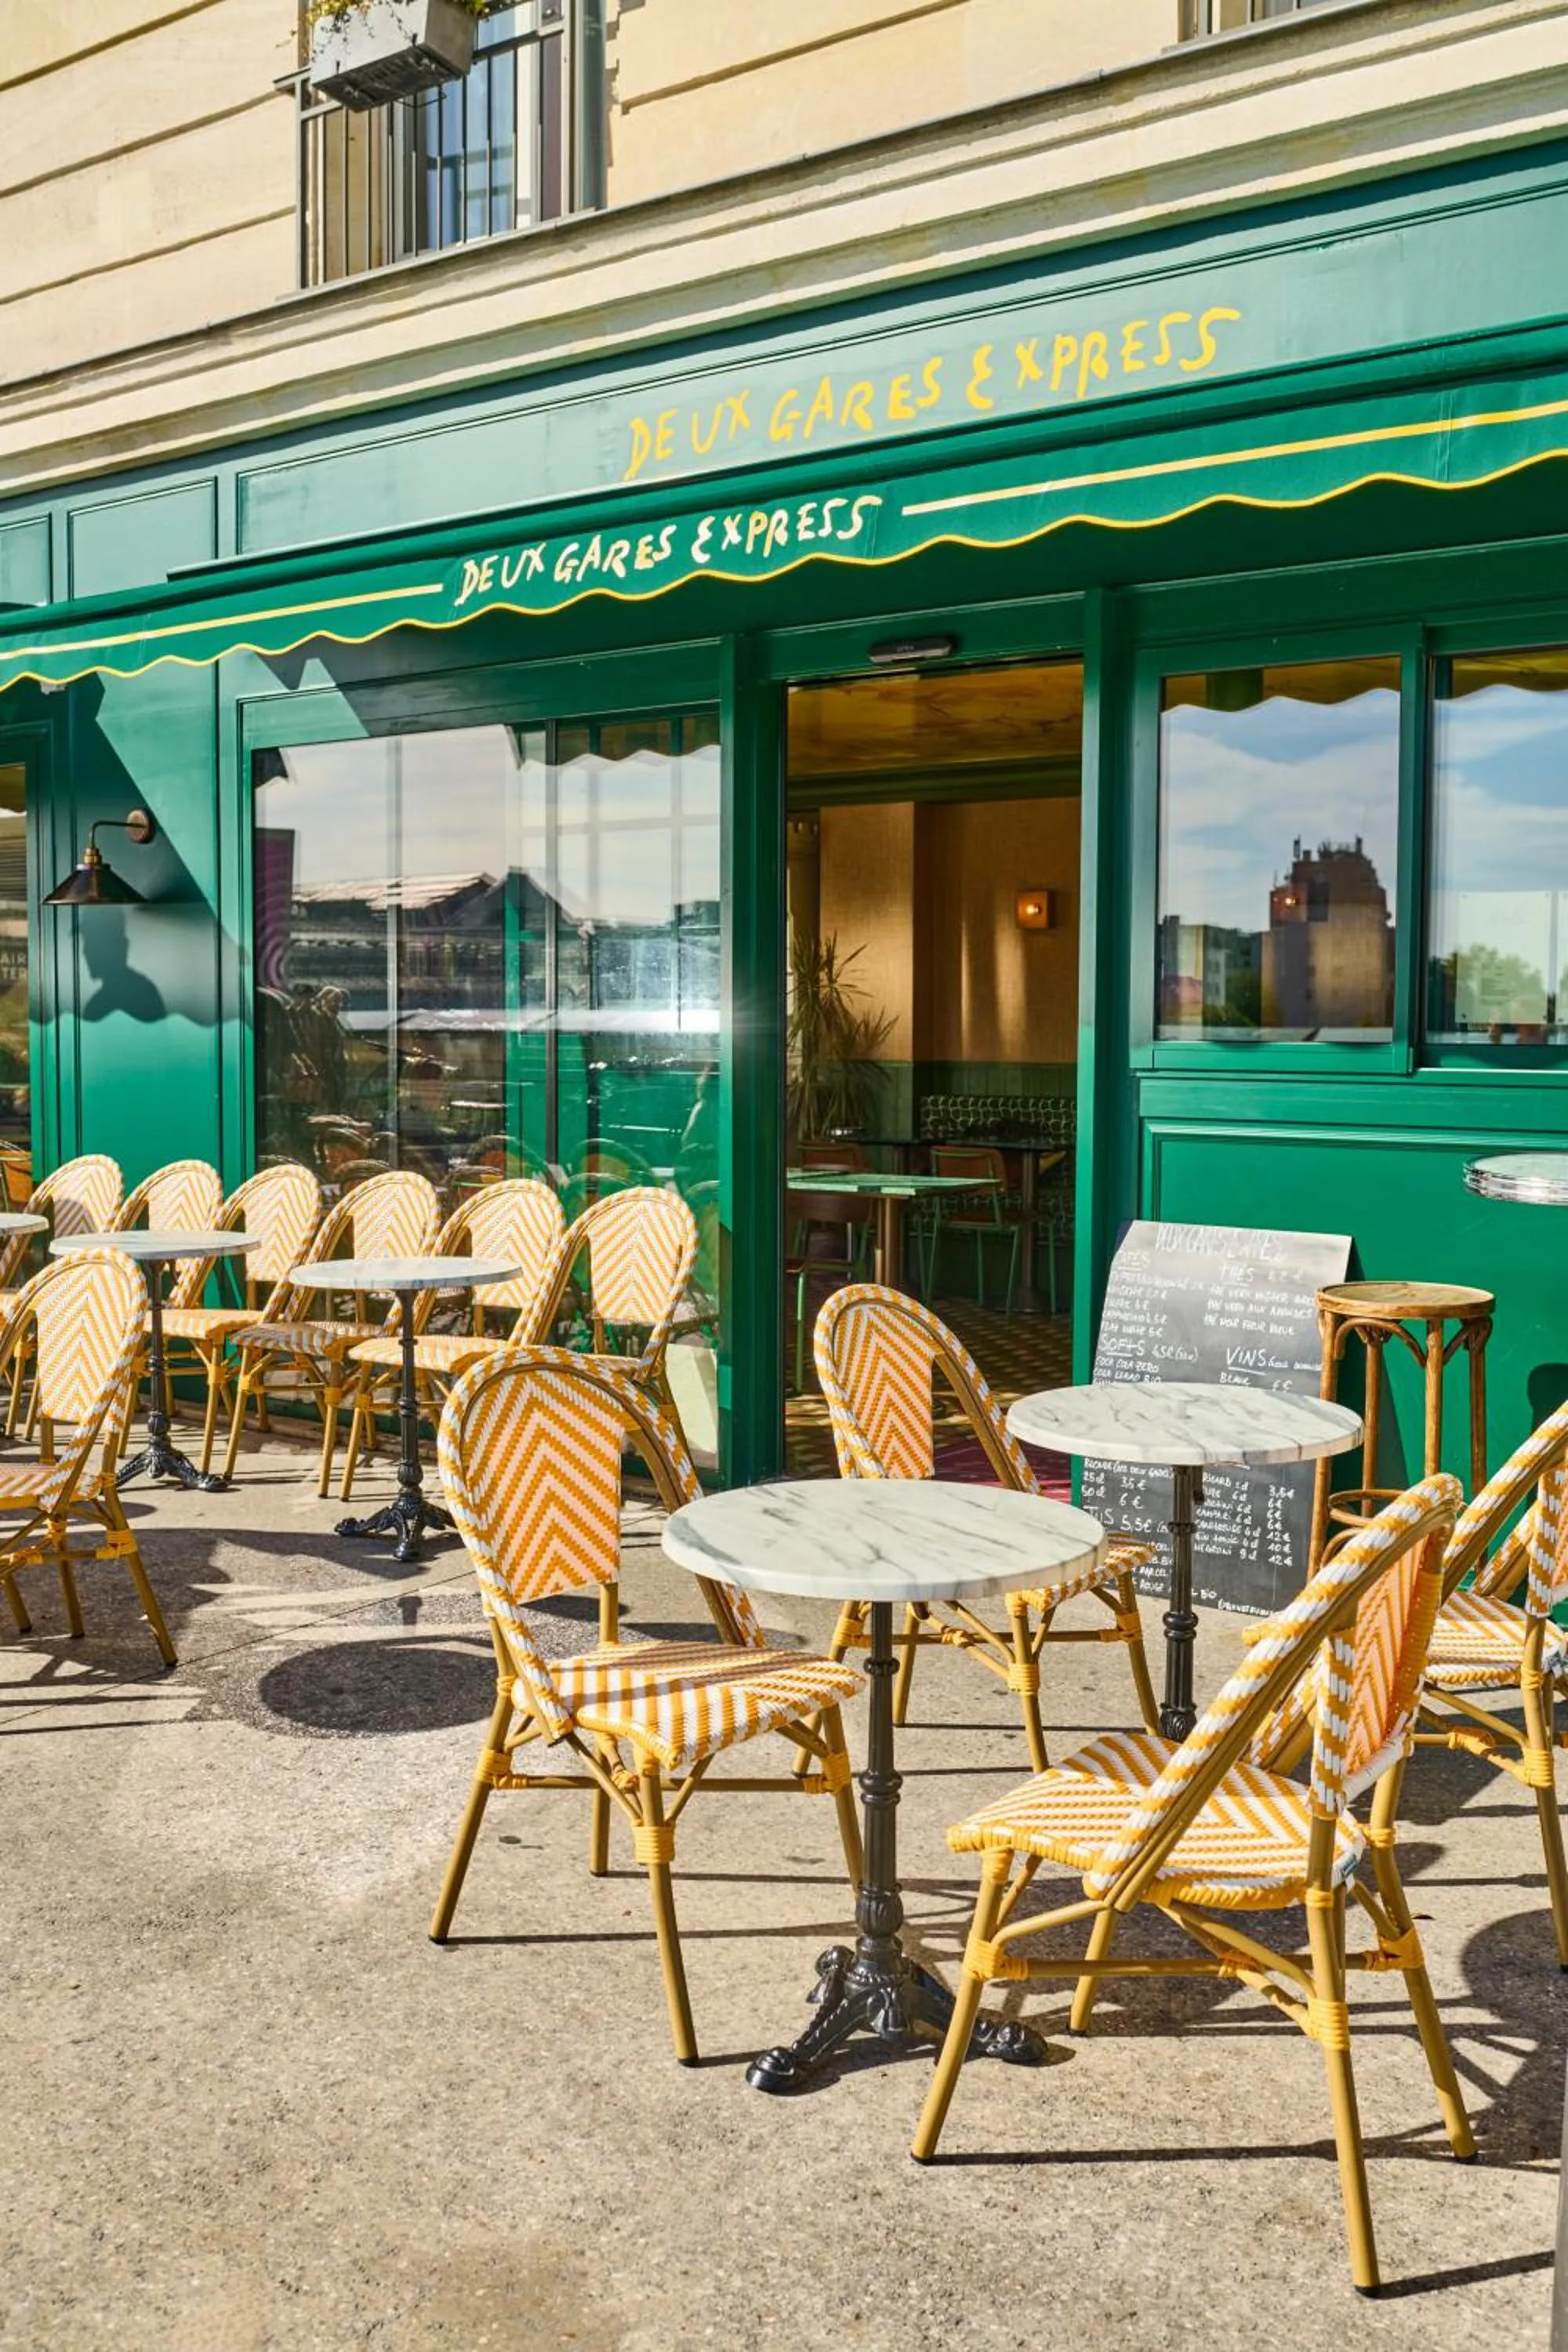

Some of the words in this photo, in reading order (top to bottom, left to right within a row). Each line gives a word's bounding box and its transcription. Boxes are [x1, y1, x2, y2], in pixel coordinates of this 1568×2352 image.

[625, 390, 753, 481] DEUX
[768, 356, 943, 442] GARES
[965, 307, 1241, 412] EXPRESS
[453, 542, 546, 606] DEUX
[553, 526, 675, 583] GARES
[691, 495, 882, 564] EXPRESS
[1098, 1332, 1145, 1356] SOFTS
[1225, 1346, 1267, 1367] VINS
